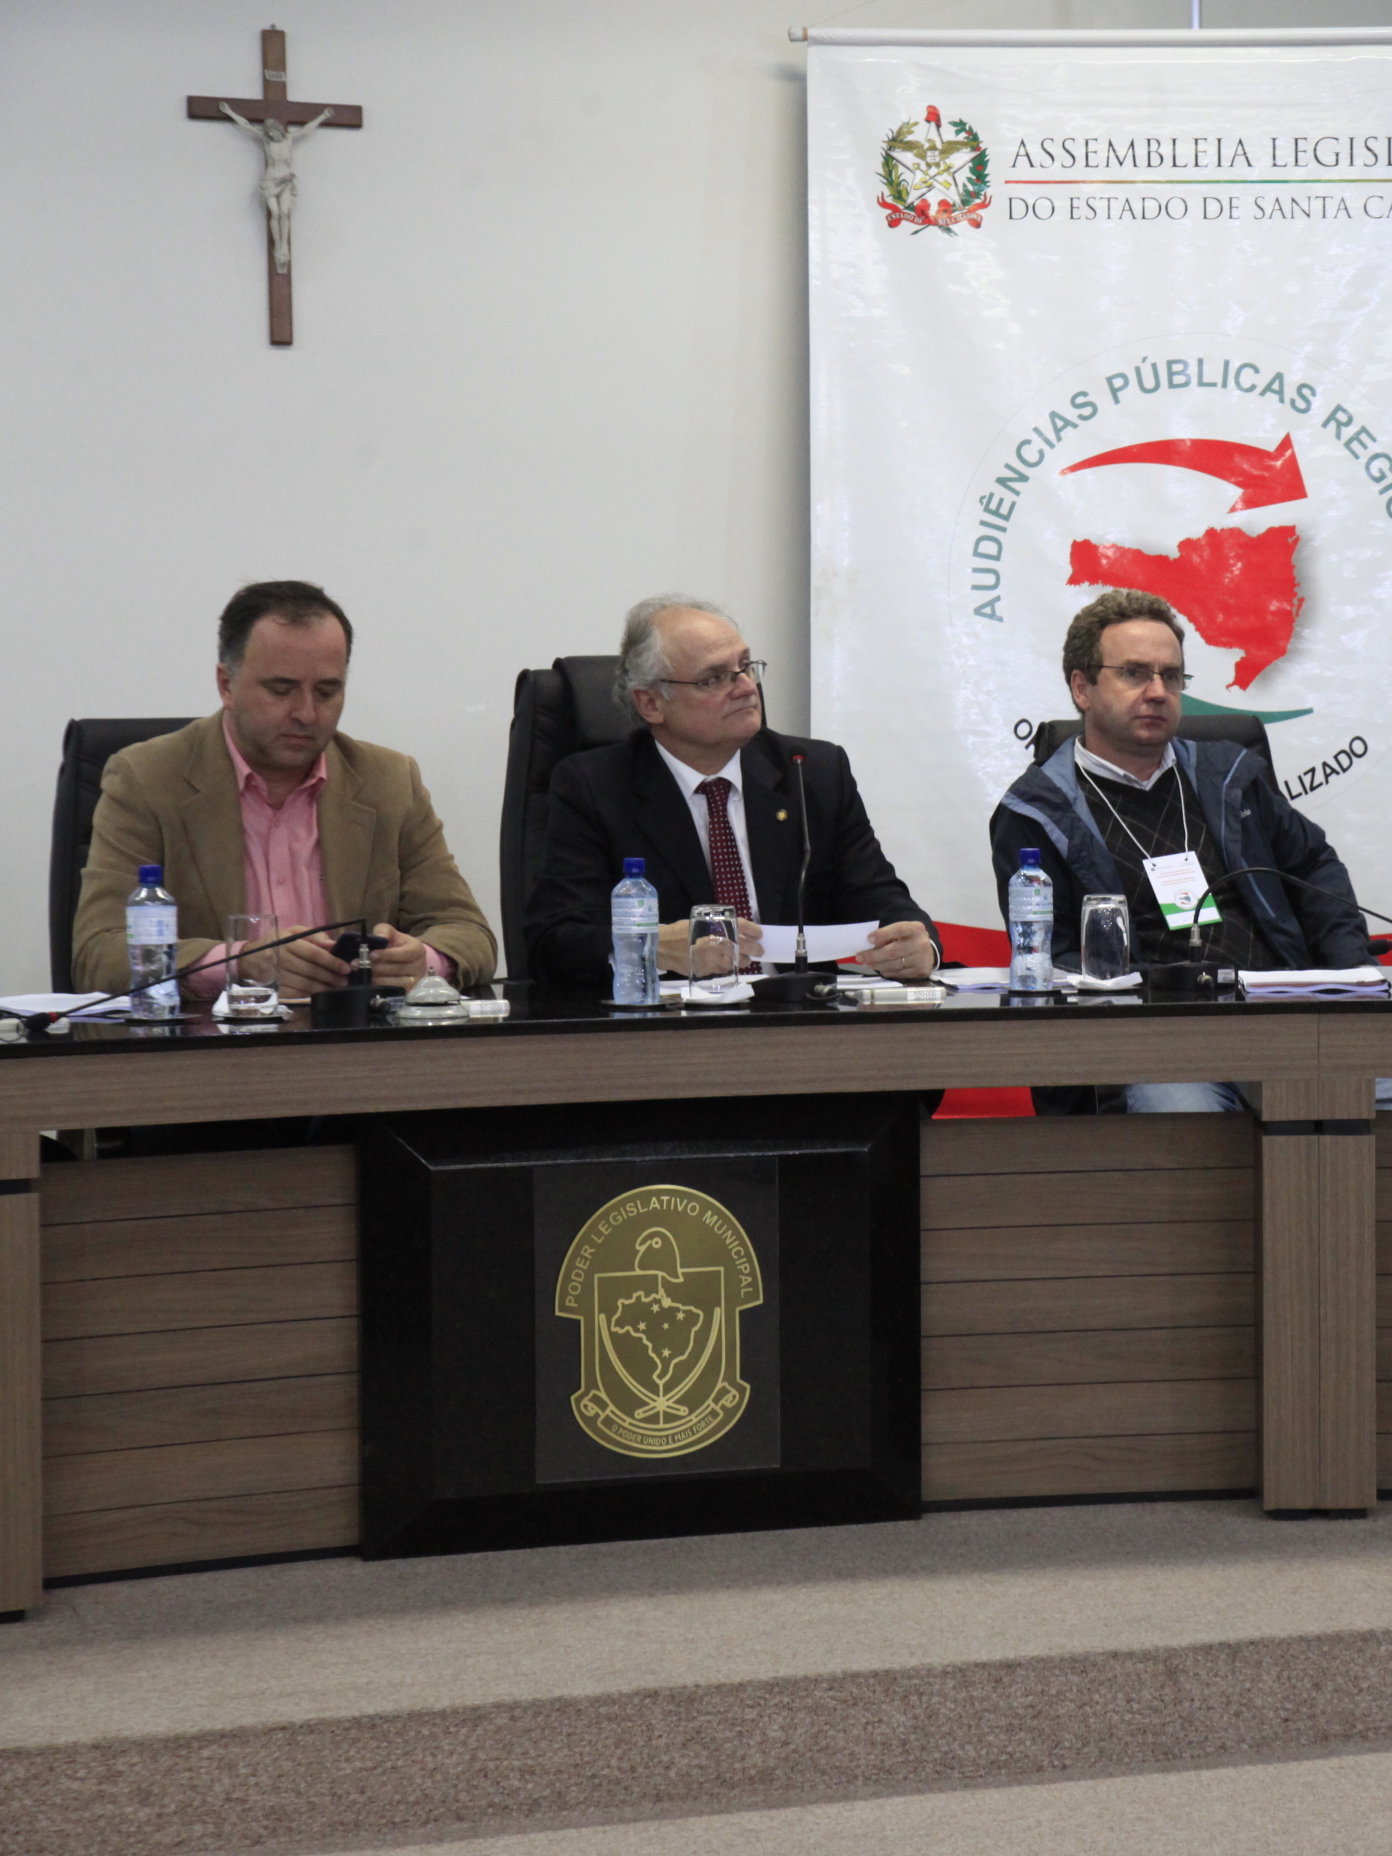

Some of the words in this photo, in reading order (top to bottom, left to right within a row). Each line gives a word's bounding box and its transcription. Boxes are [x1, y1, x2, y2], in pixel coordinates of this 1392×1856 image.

[1010, 137, 1254, 169] ASSEMBLEIA
[1007, 196, 1055, 221] DO
[1068, 196, 1189, 221] ESTADO
[1202, 196, 1241, 221] DE
[1253, 195, 1354, 221] SANTA
[970, 390, 1099, 623] AUDIÊNCIAS
[1105, 356, 1317, 414] PÚBLICAS
[565, 1244, 596, 1307] PODER
[591, 1196, 700, 1244] LEGISLATIVO
[702, 1210, 754, 1298] MUNICIPAL
[611, 1423, 618, 1432] O
[617, 1427, 642, 1443] PODER
[643, 1436, 667, 1446] UNIDO
[674, 1428, 693, 1442] MAIS
[692, 1415, 714, 1433] FORTE
